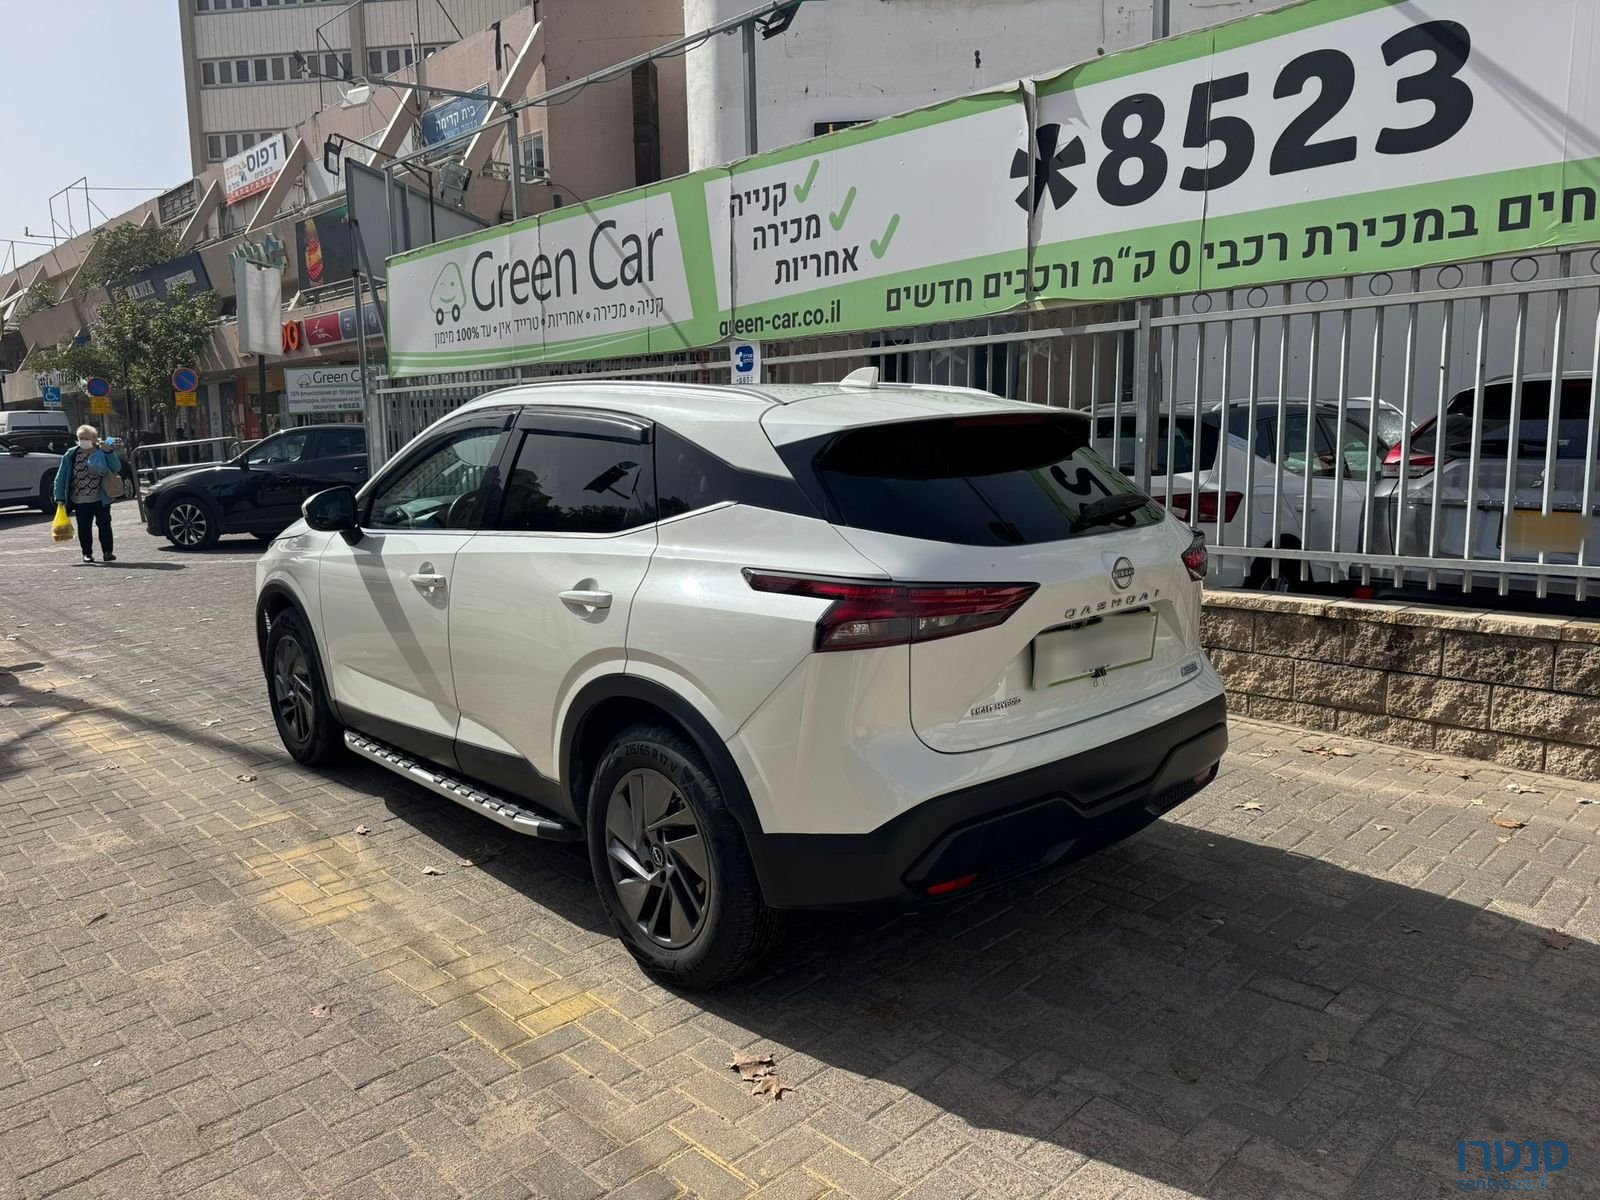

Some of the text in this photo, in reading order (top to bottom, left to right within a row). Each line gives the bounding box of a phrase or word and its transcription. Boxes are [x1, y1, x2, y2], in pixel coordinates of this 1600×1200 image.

[435, 112, 459, 132] קדימה
[462, 105, 476, 121] בית
[246, 142, 278, 172] דפוס
[730, 182, 787, 218] קנייה
[753, 213, 821, 251] מכירה
[1302, 203, 1479, 259] במכירת
[471, 219, 664, 312] Green Car
[775, 245, 859, 285] אחריות
[1169, 240, 1191, 275] 0
[1204, 231, 1288, 270] רכבי
[886, 276, 973, 312] חדשים
[983, 259, 1080, 299] ורכבים
[434, 296, 664, 349] קניה מכירה אחריות טרייד אין עד 100% מימון
[312, 369, 361, 384] Green C
[1112, 567, 1135, 578] NISSAN
[1064, 588, 1160, 620] QASHQAI
[624, 743, 650, 756] 215/65
